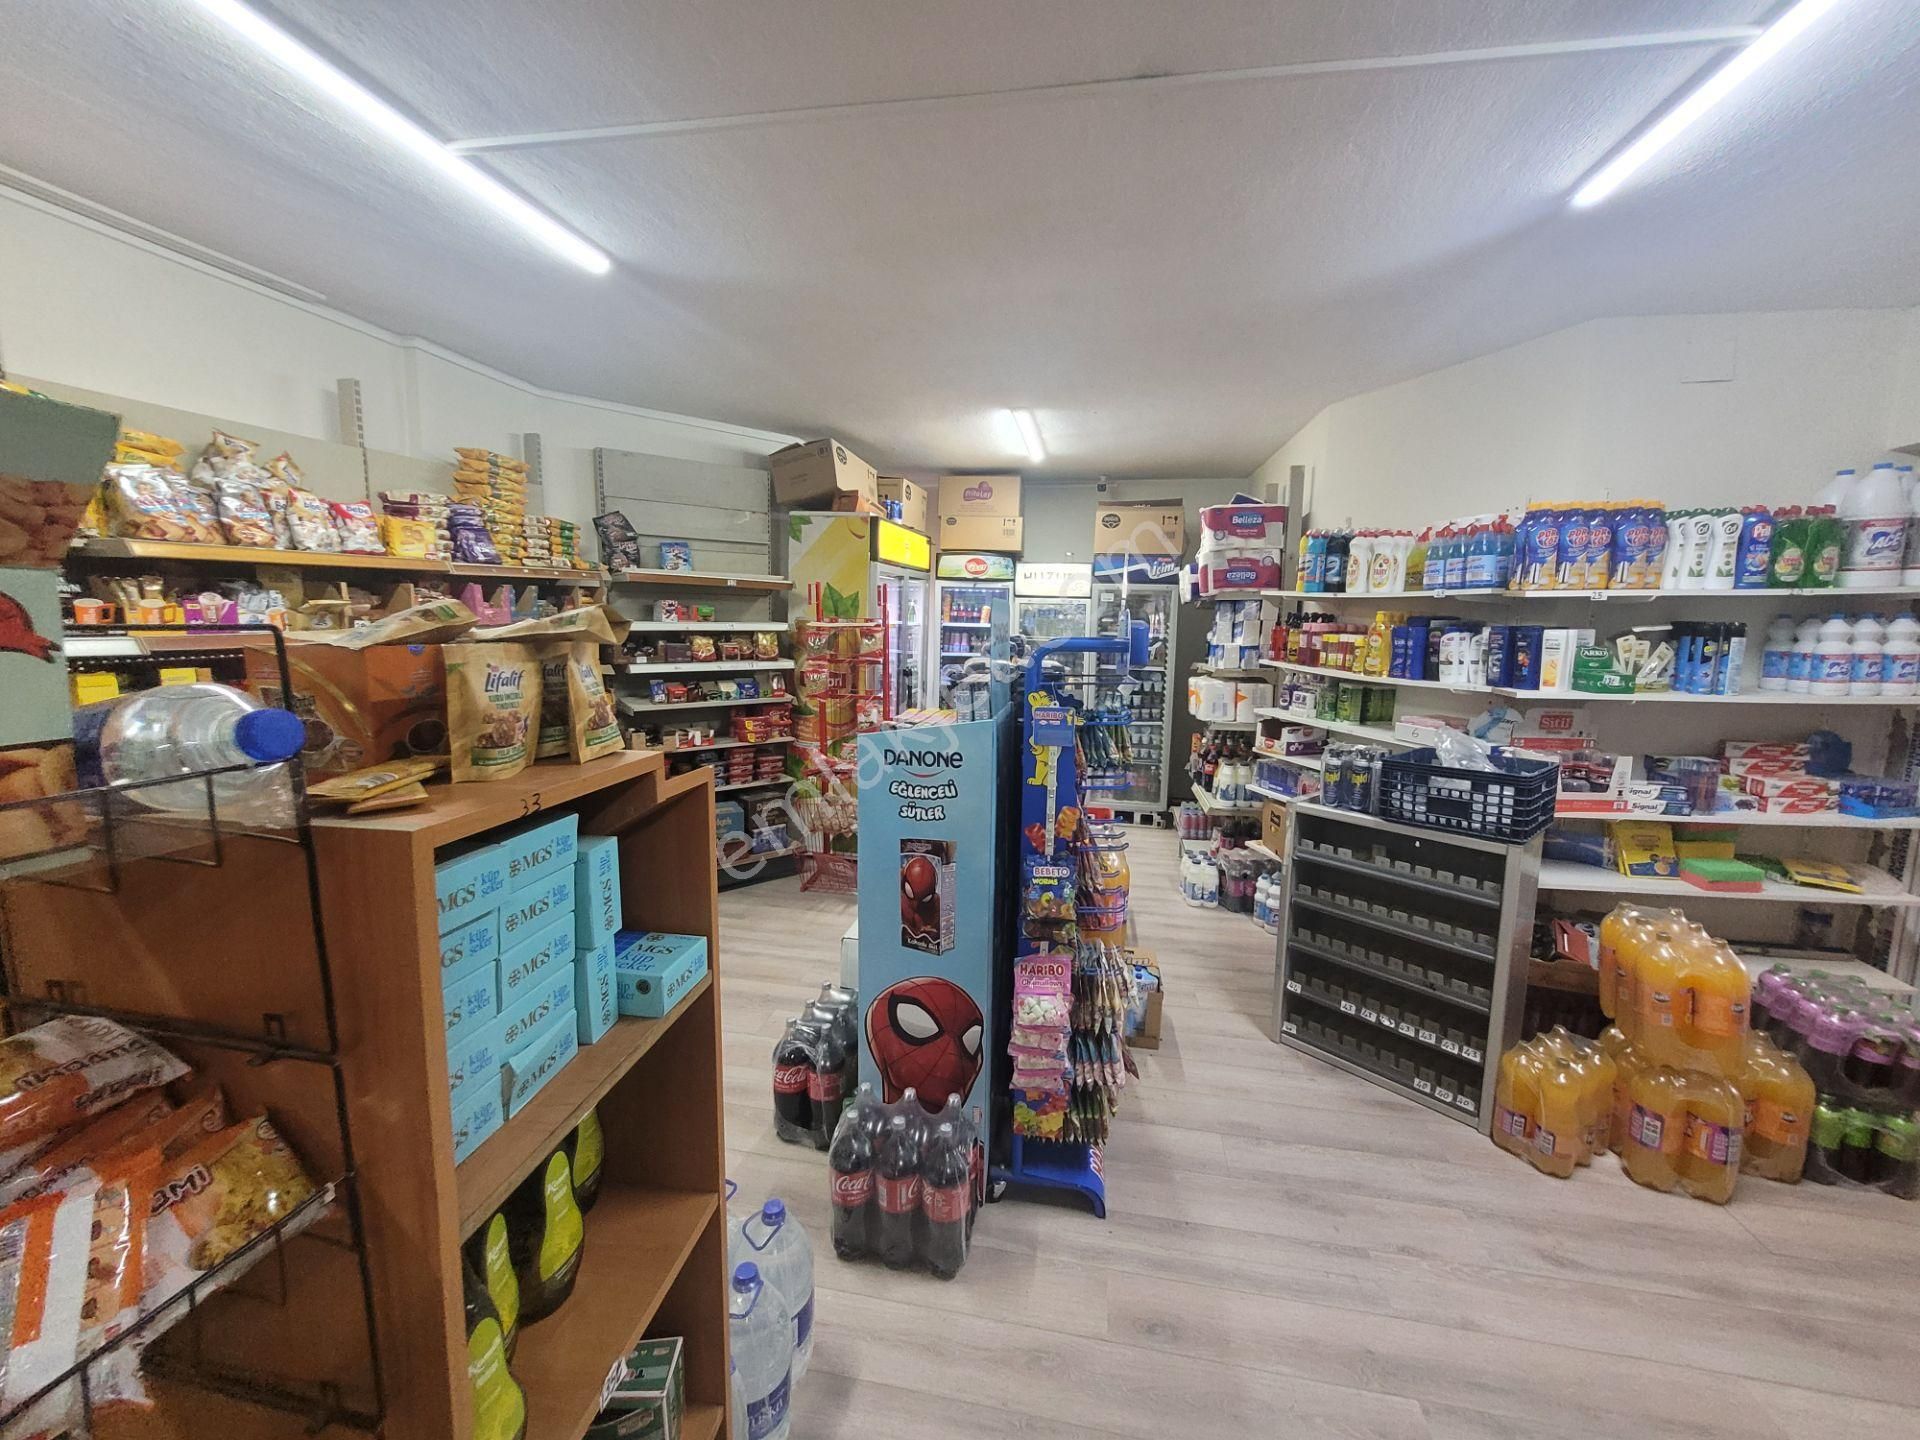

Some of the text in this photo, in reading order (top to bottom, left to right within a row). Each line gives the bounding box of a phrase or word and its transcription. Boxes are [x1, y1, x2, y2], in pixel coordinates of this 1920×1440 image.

[1231, 515, 1263, 524] Belleza
[1871, 531, 1903, 551] ACE
[1226, 571, 1257, 580] Belleza
[484, 668, 526, 694] Lifalif
[543, 664, 566, 681] falif
[1034, 710, 1064, 720] HARIBO
[888, 780, 959, 800] EĞLENCELİ
[898, 803, 946, 822] SÜTLER
[1631, 802, 1658, 811] Signal
[522, 844, 553, 872] MGS
[1033, 866, 1070, 878] BEBETO
[1032, 877, 1059, 886] WORMS
[519, 896, 550, 925] MGS
[441, 943, 464, 969] GS
[522, 946, 551, 979] MGS
[1019, 963, 1065, 977] HARIBO
[520, 1000, 550, 1035] MGS
[1464, 1047, 1478, 1059] 43
